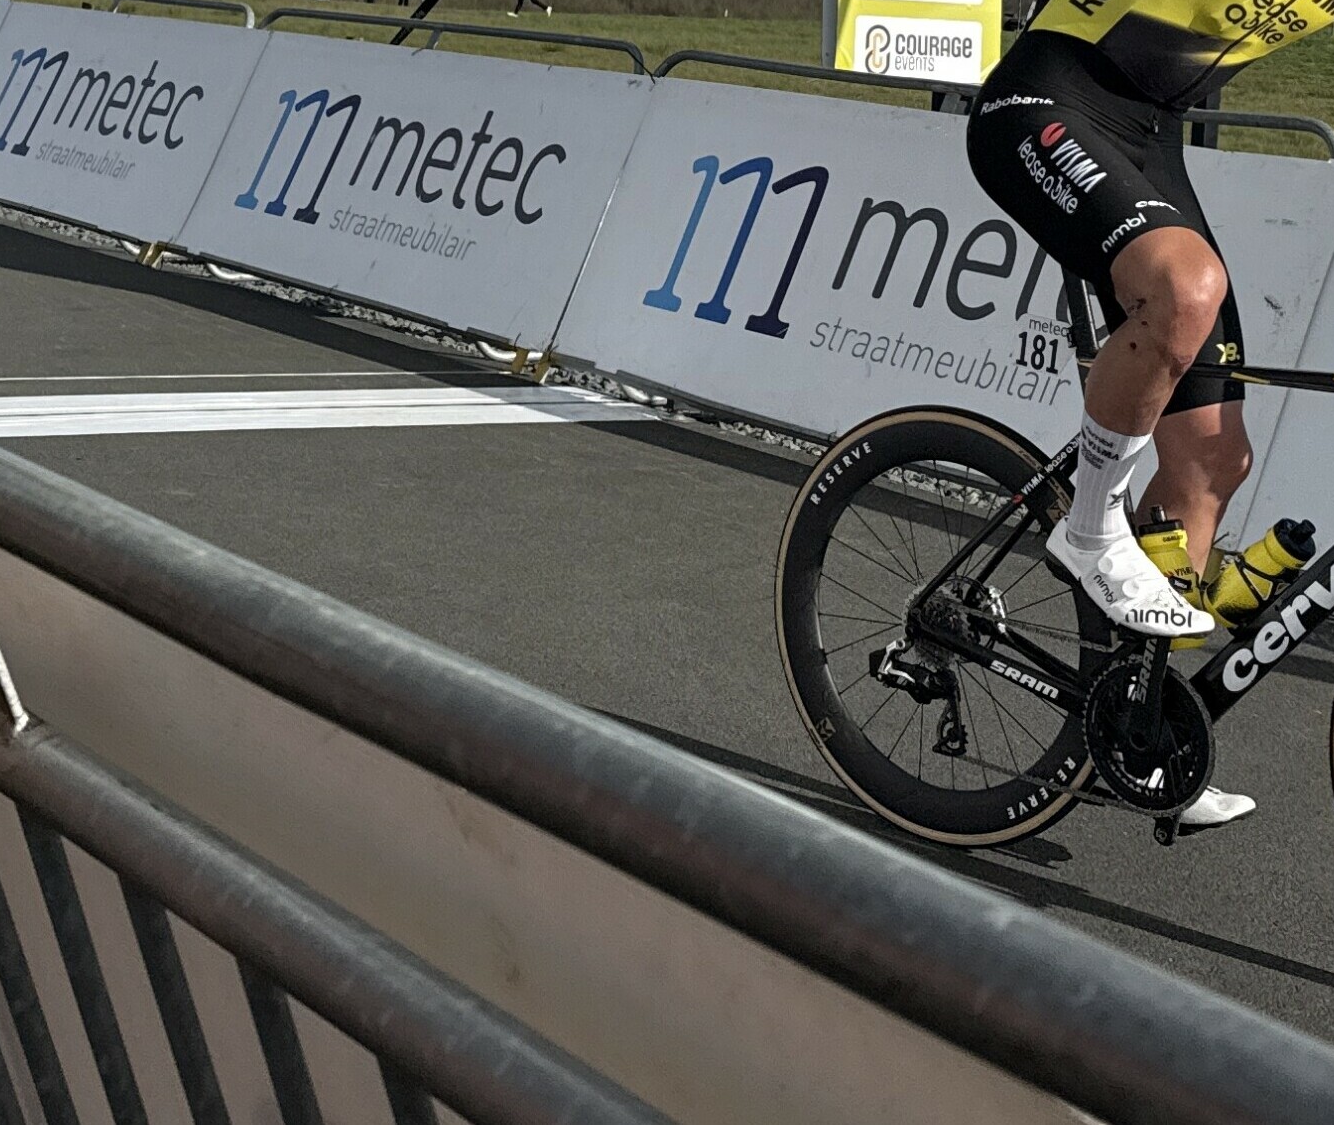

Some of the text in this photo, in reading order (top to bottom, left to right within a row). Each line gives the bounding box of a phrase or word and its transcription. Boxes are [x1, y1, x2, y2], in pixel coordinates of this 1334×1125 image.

[53, 60, 204, 150] metec
[980, 92, 1055, 115] Rabobank
[36, 139, 136, 181] straatmeubilair
[348, 110, 567, 225] metec
[1017, 134, 1044, 184] lease
[1049, 138, 1108, 194] VISMA
[328, 206, 477, 261] straatmeubilair
[1100, 212, 1147, 253] nimbl
[809, 316, 1072, 406] straatmeubilair
[1015, 331, 1059, 374] 181
[809, 441, 873, 507] RESERVE
[1093, 574, 1118, 605] nimbl
[1125, 608, 1192, 628] nimbl
[990, 659, 1060, 700] SRAM
[1006, 755, 1077, 821] REERVE
